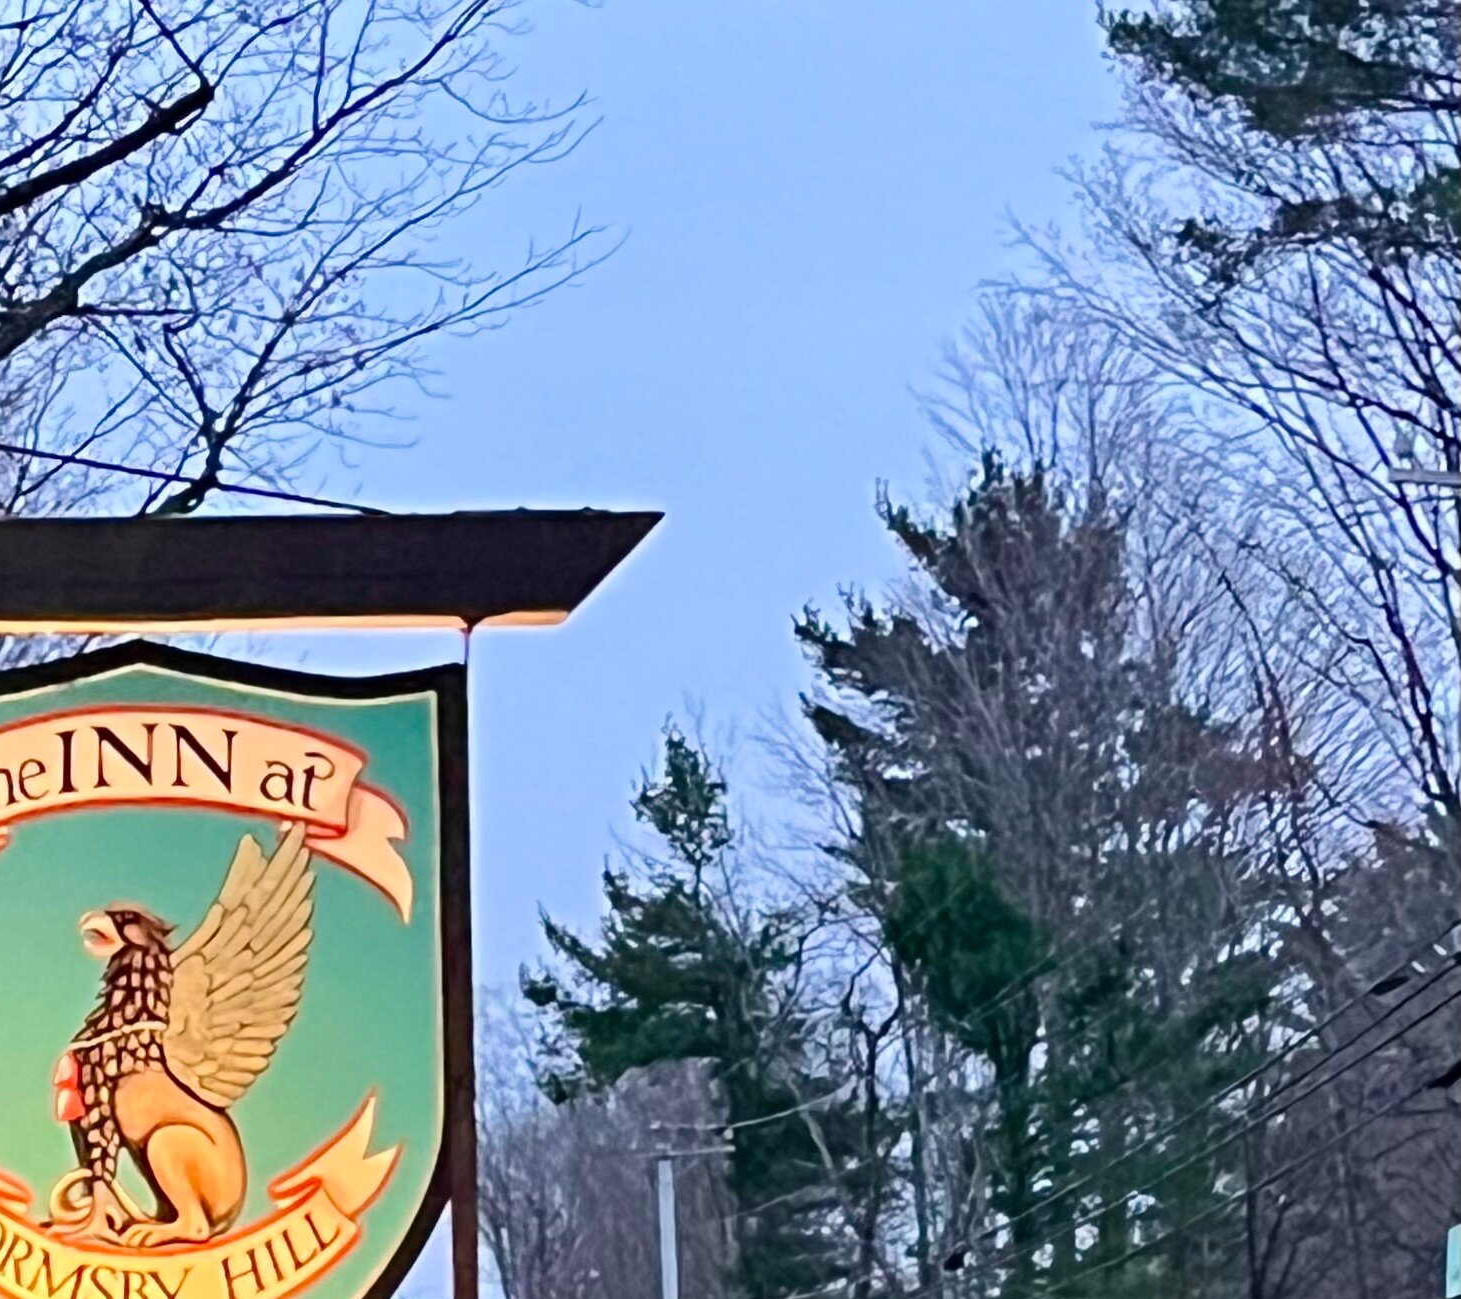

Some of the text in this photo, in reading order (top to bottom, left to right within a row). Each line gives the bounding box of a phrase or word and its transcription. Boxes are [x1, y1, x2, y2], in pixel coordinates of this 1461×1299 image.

[55, 723, 238, 794] INN
[260, 752, 336, 811] at
[221, 1210, 340, 1293] HILL
